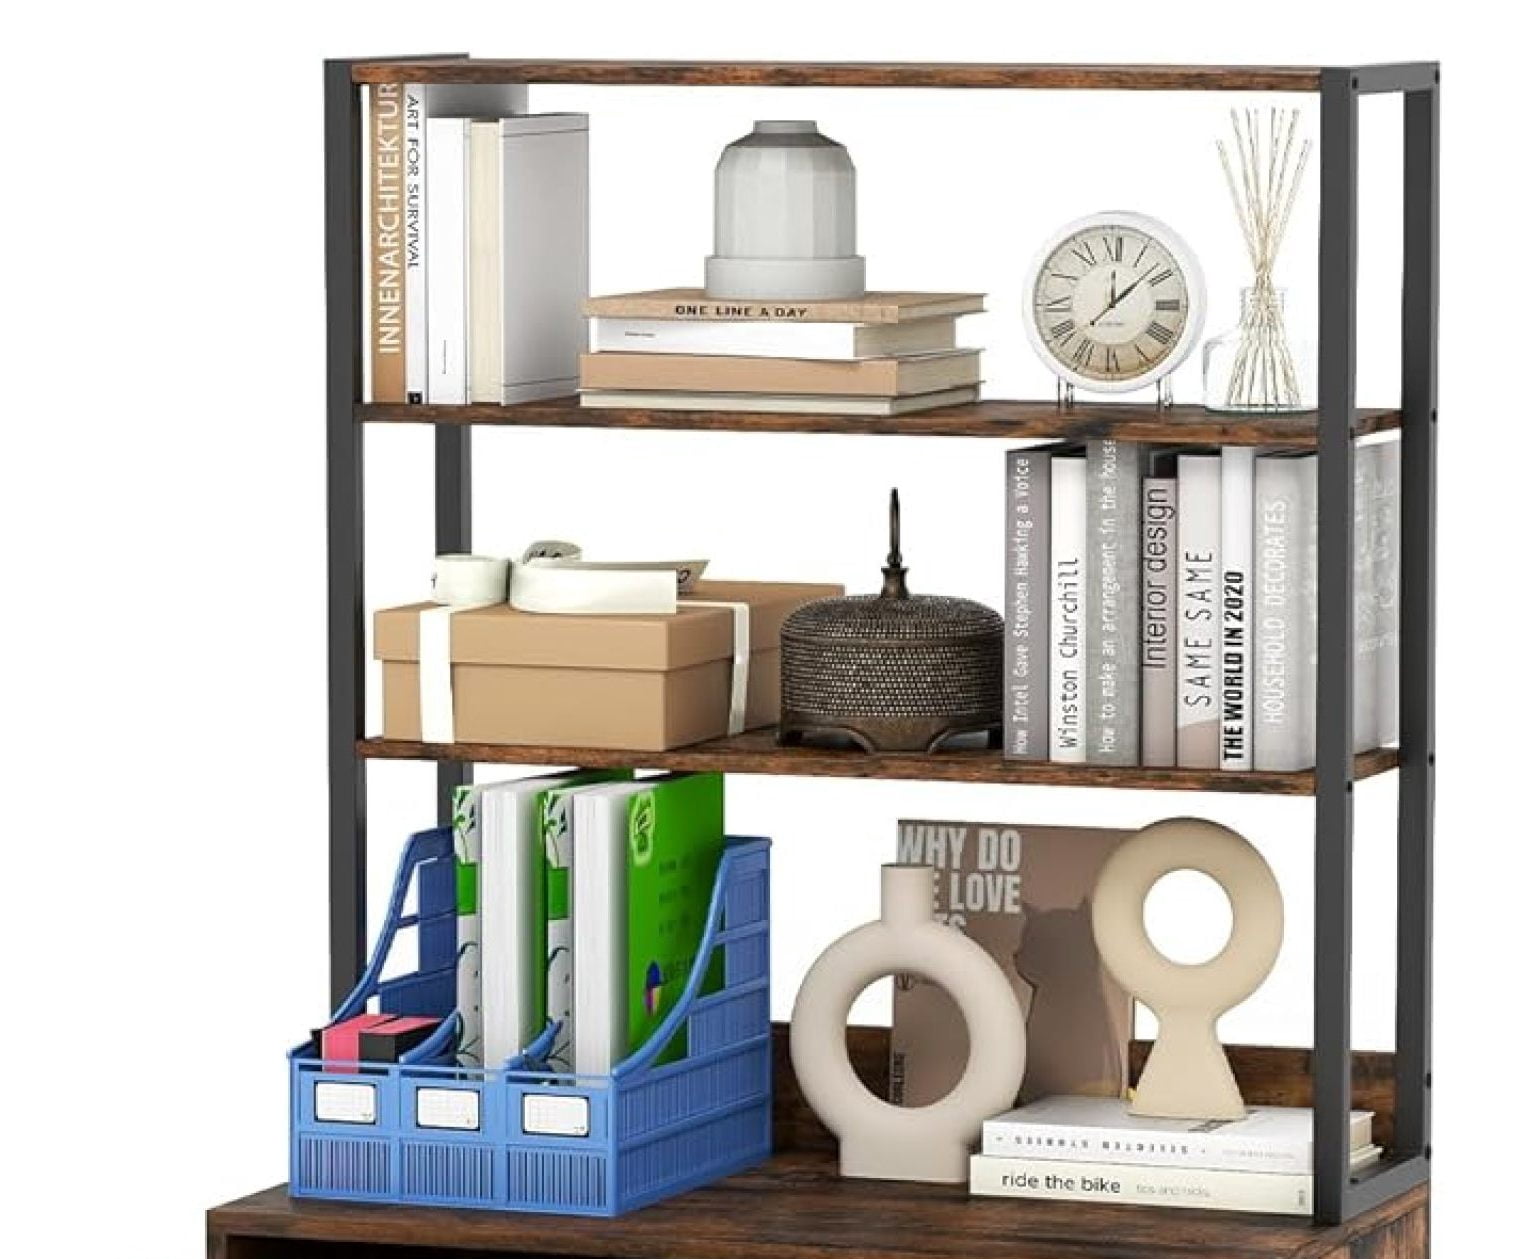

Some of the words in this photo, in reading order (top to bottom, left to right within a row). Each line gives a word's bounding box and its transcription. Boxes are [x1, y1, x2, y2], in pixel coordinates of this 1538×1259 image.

[407, 94, 419, 129] ART
[407, 138, 419, 177] FOR
[377, 84, 400, 354] INNENARCHITEKTUR
[407, 183, 419, 269] SURVIVAL
[675, 305, 708, 317] ONE
[715, 305, 752, 317] LINE
[759, 306, 770, 318] A
[774, 307, 807, 319] DAY
[1012, 458, 1030, 498] Voice
[1015, 504, 1030, 515] a
[1099, 486, 1117, 511] the
[1099, 518, 1117, 536] in
[1146, 486, 1176, 572] design
[1012, 520, 1033, 576] Hawking
[1263, 500, 1288, 608] DECORATES
[1100, 542, 1120, 633] arrangement
[1185, 551, 1213, 622] SAME
[1223, 571, 1244, 623] 2020
[1012, 582, 1031, 638] Stephen
[1058, 557, 1079, 660] Churchill
[1141, 580, 1167, 669] Interior
[1102, 640, 1117, 657] an
[1223, 626, 1244, 648] IN
[1013, 645, 1030, 678] Gave
[1099, 663, 1117, 698] make
[1185, 636, 1212, 708] SAME
[1262, 617, 1286, 725] HOUSEHOLD
[1012, 684, 1029, 722] Intel
[1223, 651, 1244, 722] WORLD
[1058, 670, 1078, 750] Winston
[1100, 704, 1117, 721] to
[1012, 730, 1029, 755] How
[1100, 727, 1117, 753] How
[1223, 723, 1244, 761] THE
[897, 825, 967, 870] WHY
[978, 828, 1020, 872] DO
[950, 872, 1021, 913] LOVE
[1001, 1173, 1039, 1188] ride
[1045, 1175, 1075, 1191] the
[1080, 1176, 1121, 1194] bike
